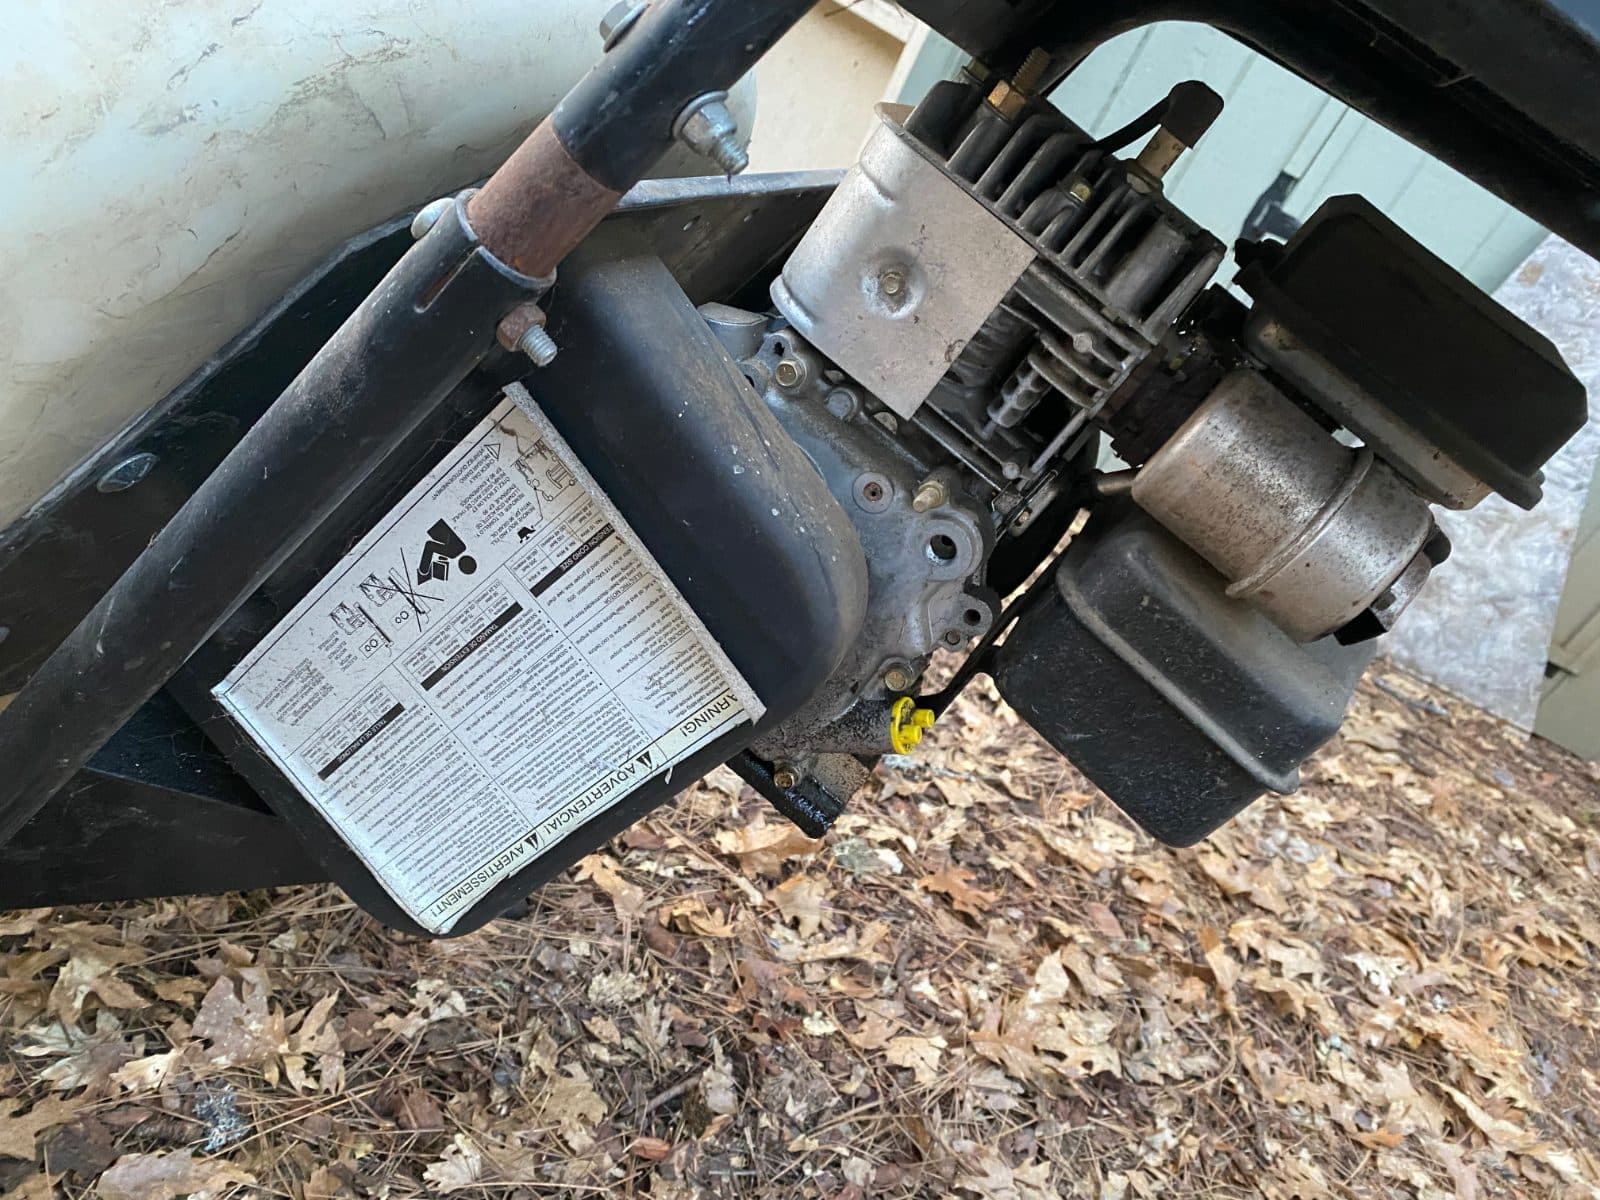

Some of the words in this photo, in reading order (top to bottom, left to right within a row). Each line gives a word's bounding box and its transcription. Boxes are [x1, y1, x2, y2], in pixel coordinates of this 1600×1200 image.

[560, 558, 573, 570] SIZE
[571, 543, 589, 561] CORD
[541, 762, 640, 834] ADVERTENCIA!
[427, 843, 529, 917] AVERTISSEMENT!
